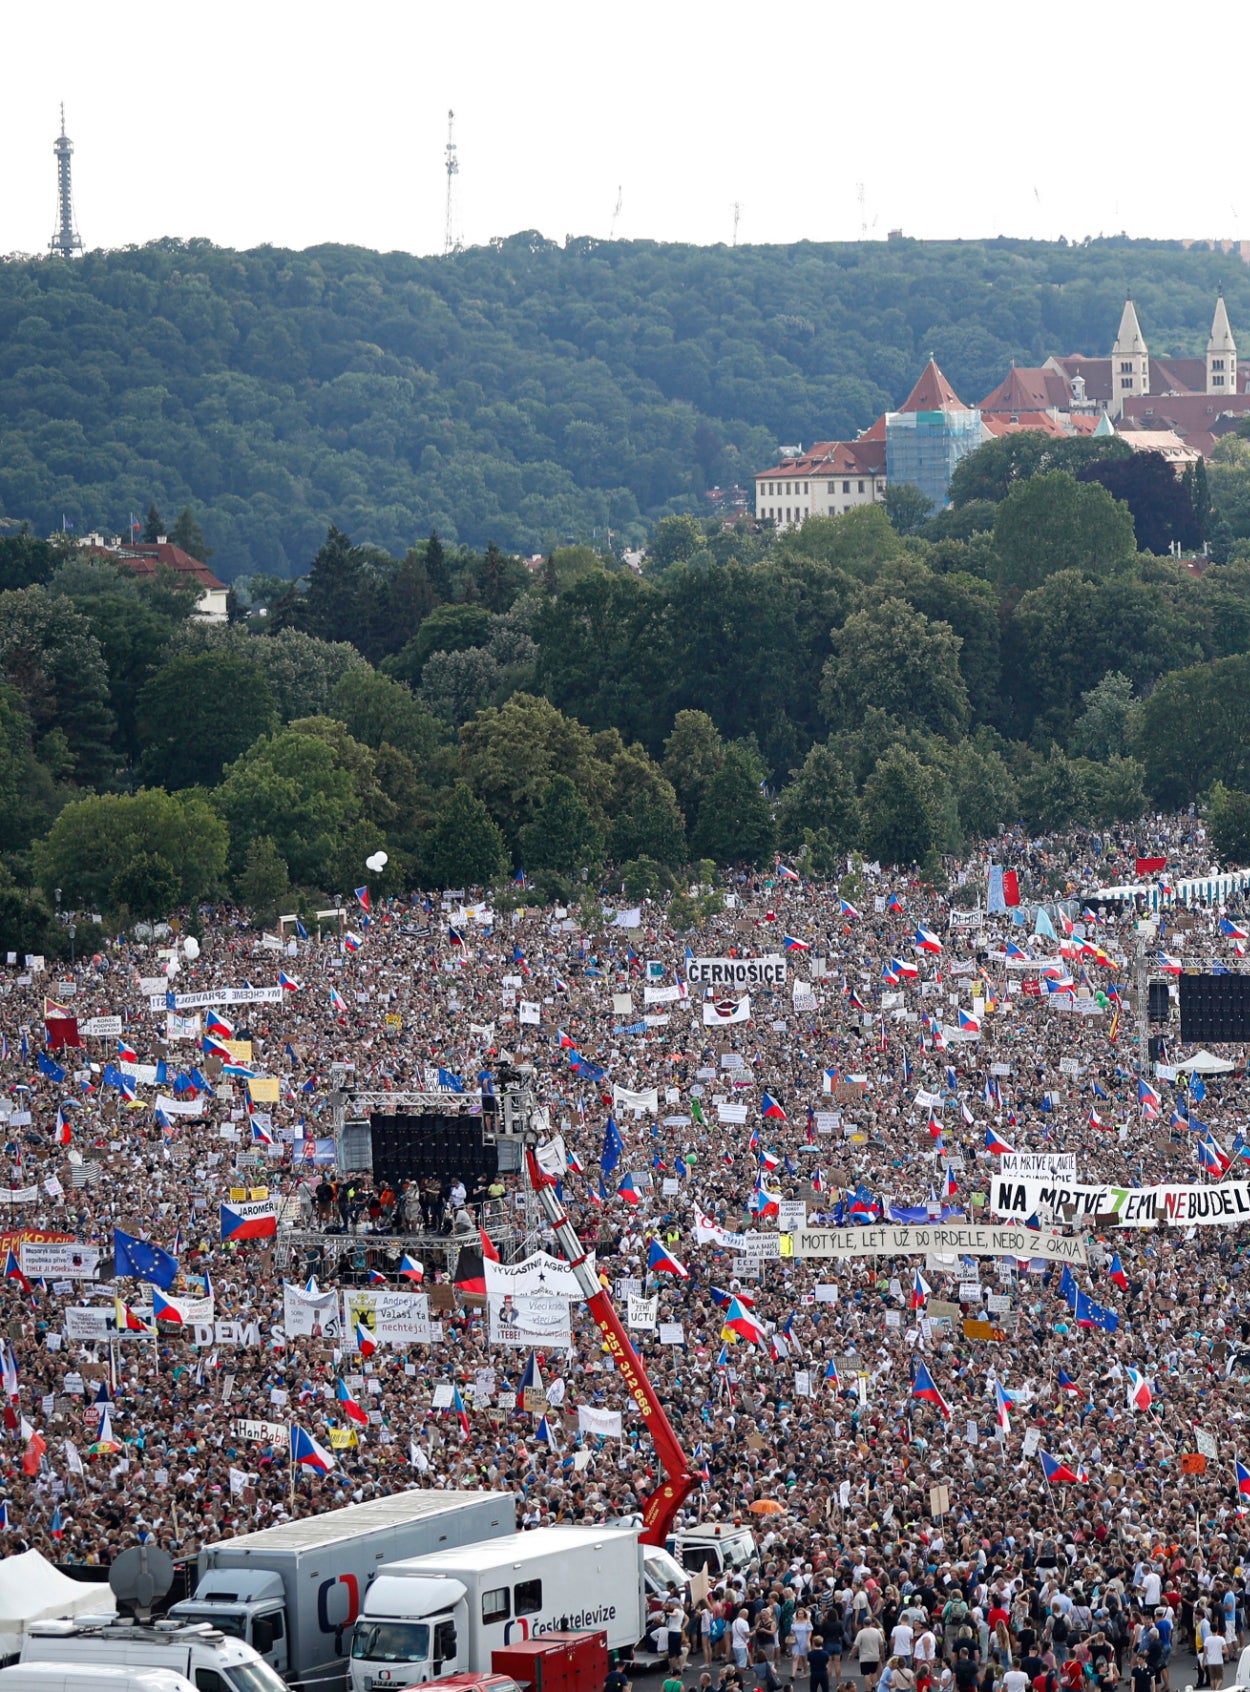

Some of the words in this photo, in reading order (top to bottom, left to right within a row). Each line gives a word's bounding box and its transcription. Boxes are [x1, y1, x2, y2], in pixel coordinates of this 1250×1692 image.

[689, 960, 785, 982] ČERNOŠICE
[1003, 1156, 1018, 1170] NA
[1020, 1154, 1046, 1170] MRTVÉ
[998, 1183, 1027, 1211] NA
[1039, 1187, 1107, 1216] MRTVÉ
[1110, 1188, 1157, 1224] ZEMI
[801, 1232, 857, 1250] MOTÝLE,
[862, 1229, 886, 1247] LEŤ
[894, 1229, 910, 1247] UŽ
[915, 1231, 930, 1246] DO
[934, 1231, 988, 1249] PRDELE,
[993, 1232, 1024, 1250] NEBO
[1030, 1236, 1040, 1251] Z
[1047, 1239, 1082, 1258] OKNA
[383, 1297, 422, 1308] Andreji,
[382, 1322, 426, 1334] nechtějí!
[501, 1331, 521, 1340] TEBE!
[605, 1331, 625, 1358] 257
[620, 1361, 639, 1389] 312
[634, 1389, 652, 1416] 666
[532, 1613, 568, 1637] česk
[570, 1604, 616, 1629] televize
